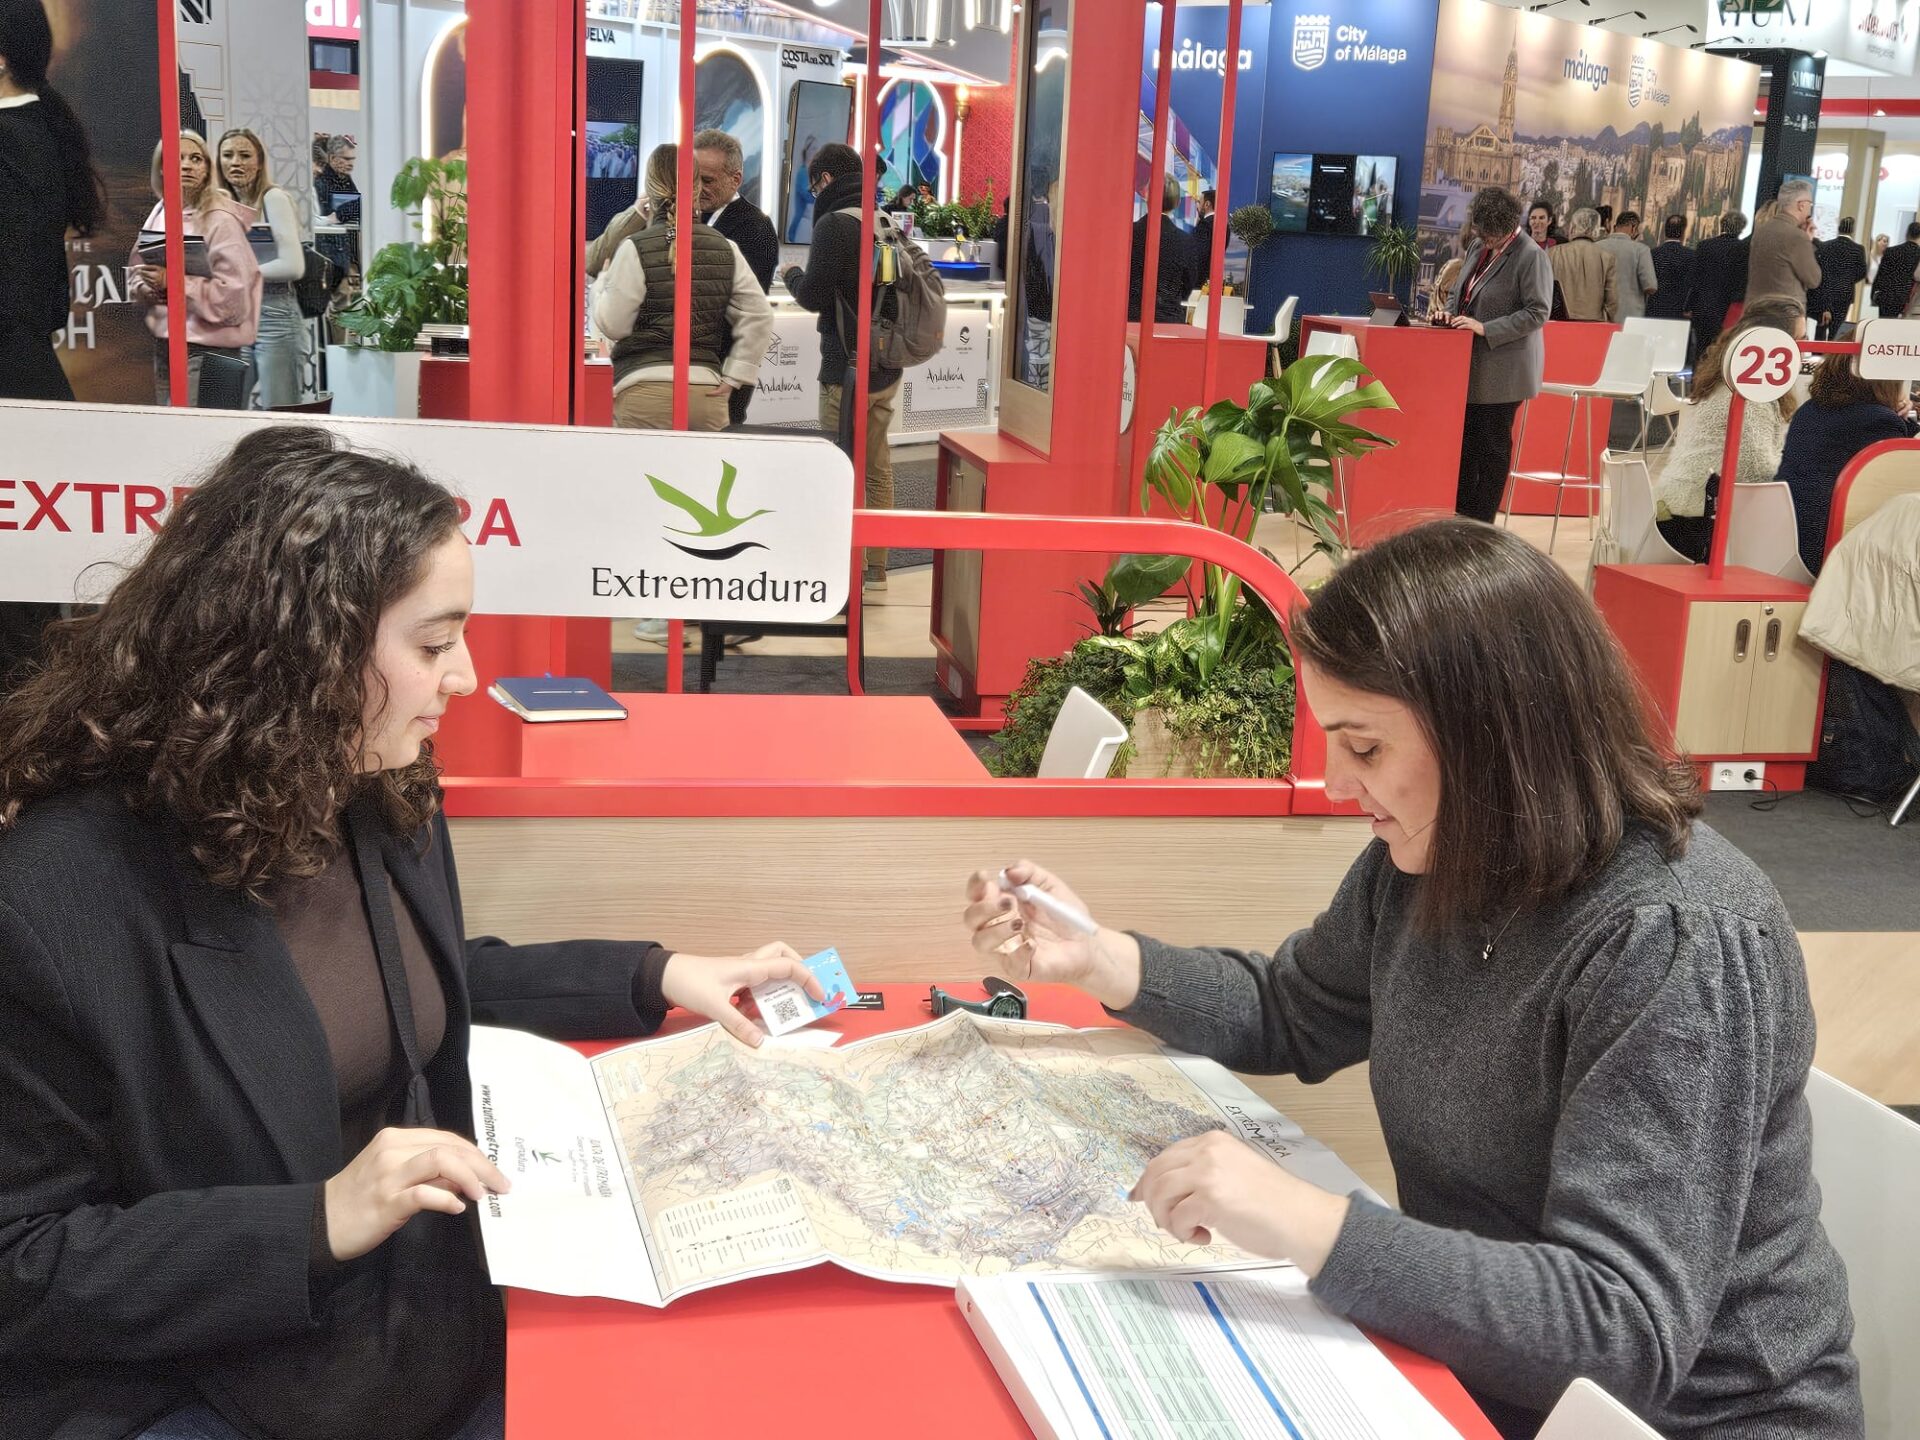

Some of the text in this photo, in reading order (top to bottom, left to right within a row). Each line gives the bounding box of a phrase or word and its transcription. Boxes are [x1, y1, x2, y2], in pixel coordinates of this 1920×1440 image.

[1336, 25, 1368, 44] City
[782, 49, 809, 63] COSTA
[818, 53, 835, 67] SOL
[1335, 44, 1407, 65] of Málaga
[1867, 344, 1920, 357] CASTILL
[1736, 345, 1793, 386] 23
[592, 567, 827, 604] Extremadura
